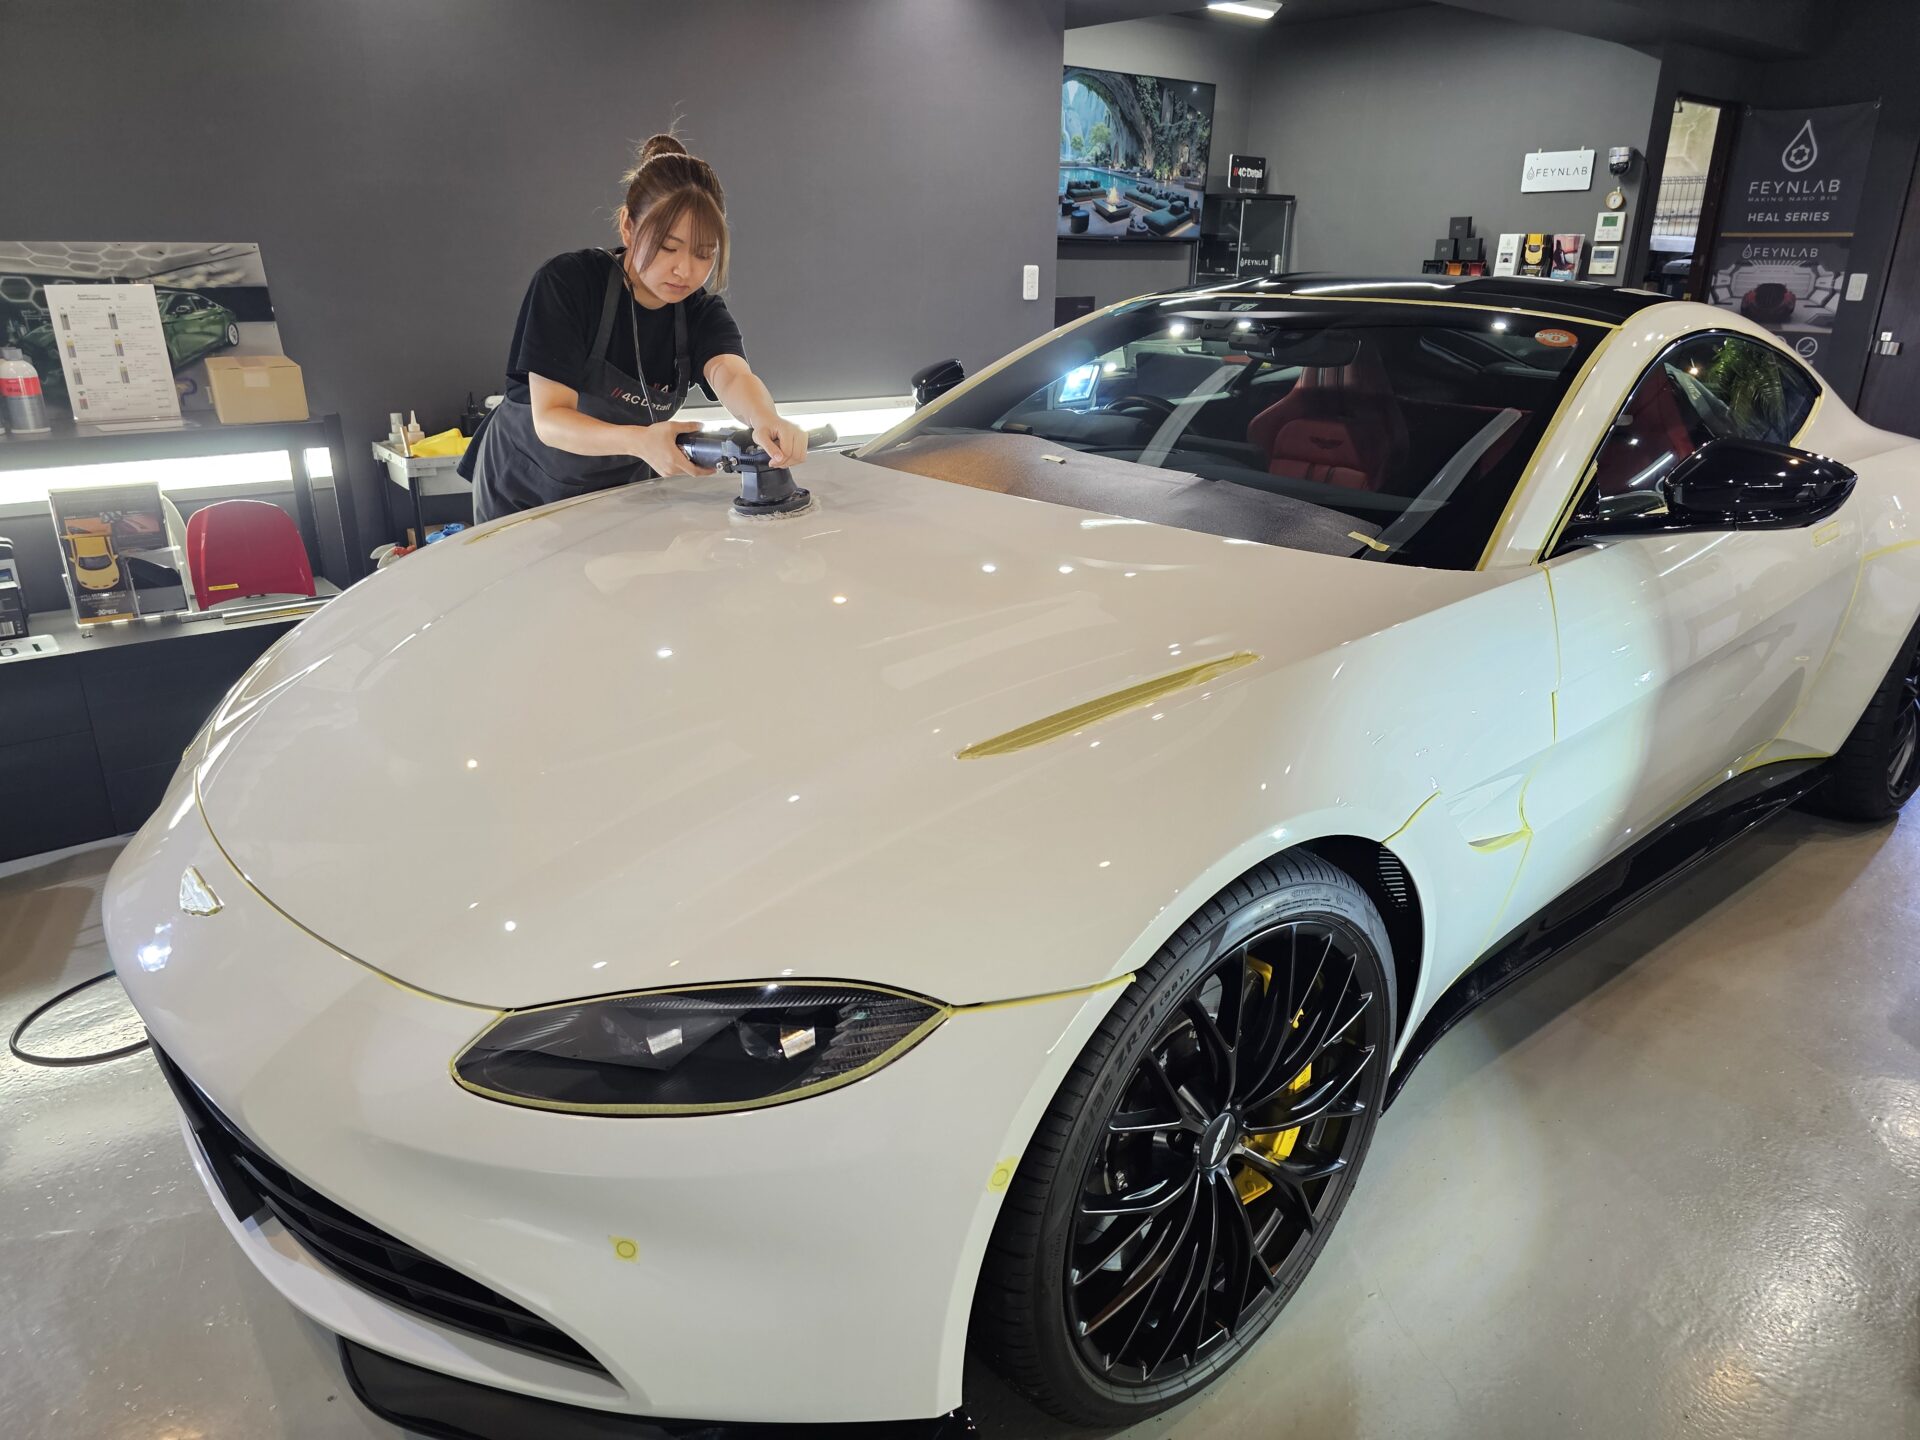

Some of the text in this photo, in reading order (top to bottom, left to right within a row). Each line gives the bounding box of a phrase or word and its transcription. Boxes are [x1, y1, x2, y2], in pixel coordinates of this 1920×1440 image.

[1535, 166, 1588, 177] FEYNLAB
[1748, 179, 1841, 195] FEYNLAB
[1747, 211, 1830, 222] HEAL SERIES
[1753, 247, 1819, 258] FEYNLAB
